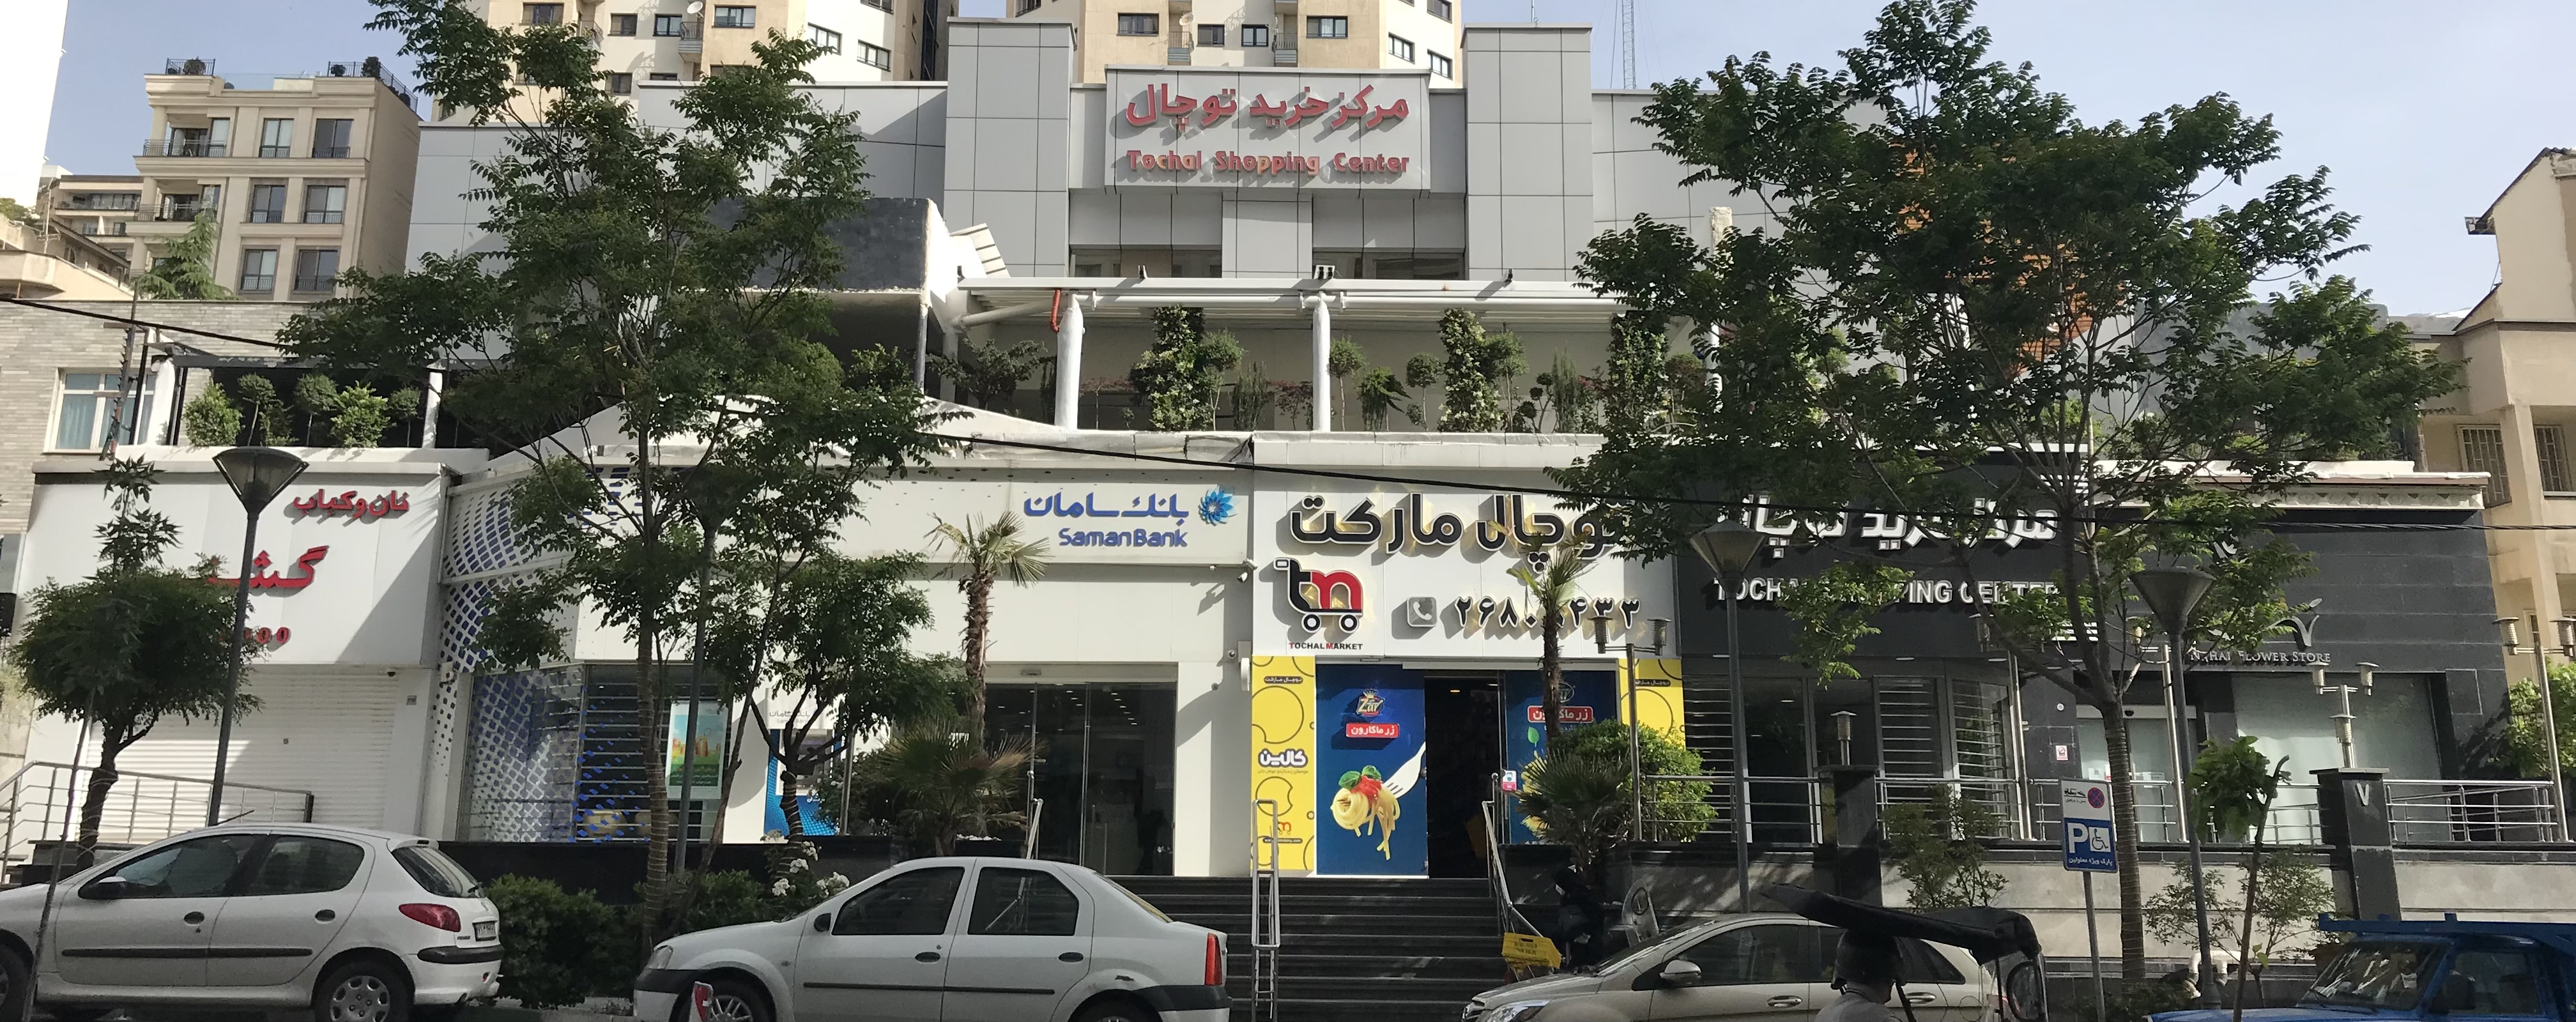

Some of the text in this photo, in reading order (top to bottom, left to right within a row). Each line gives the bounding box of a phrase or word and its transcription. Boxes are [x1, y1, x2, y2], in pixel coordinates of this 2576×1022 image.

[1126, 82, 1409, 133] مرکز خرید توچال
[1126, 149, 1409, 176] Tochal Shopping Center
[369, 490, 410, 516] نان
[1023, 491, 1121, 519] سامان
[1289, 491, 1633, 575] وچال مارکت
[1325, 642, 1363, 650] MARKET
[2292, 650, 2331, 662] STORE
[1350, 725, 1395, 736] زر ماکارون
[1259, 749, 1308, 767] کالین
[2067, 822, 2089, 853] P
[2100, 858, 2113, 867] پارک
